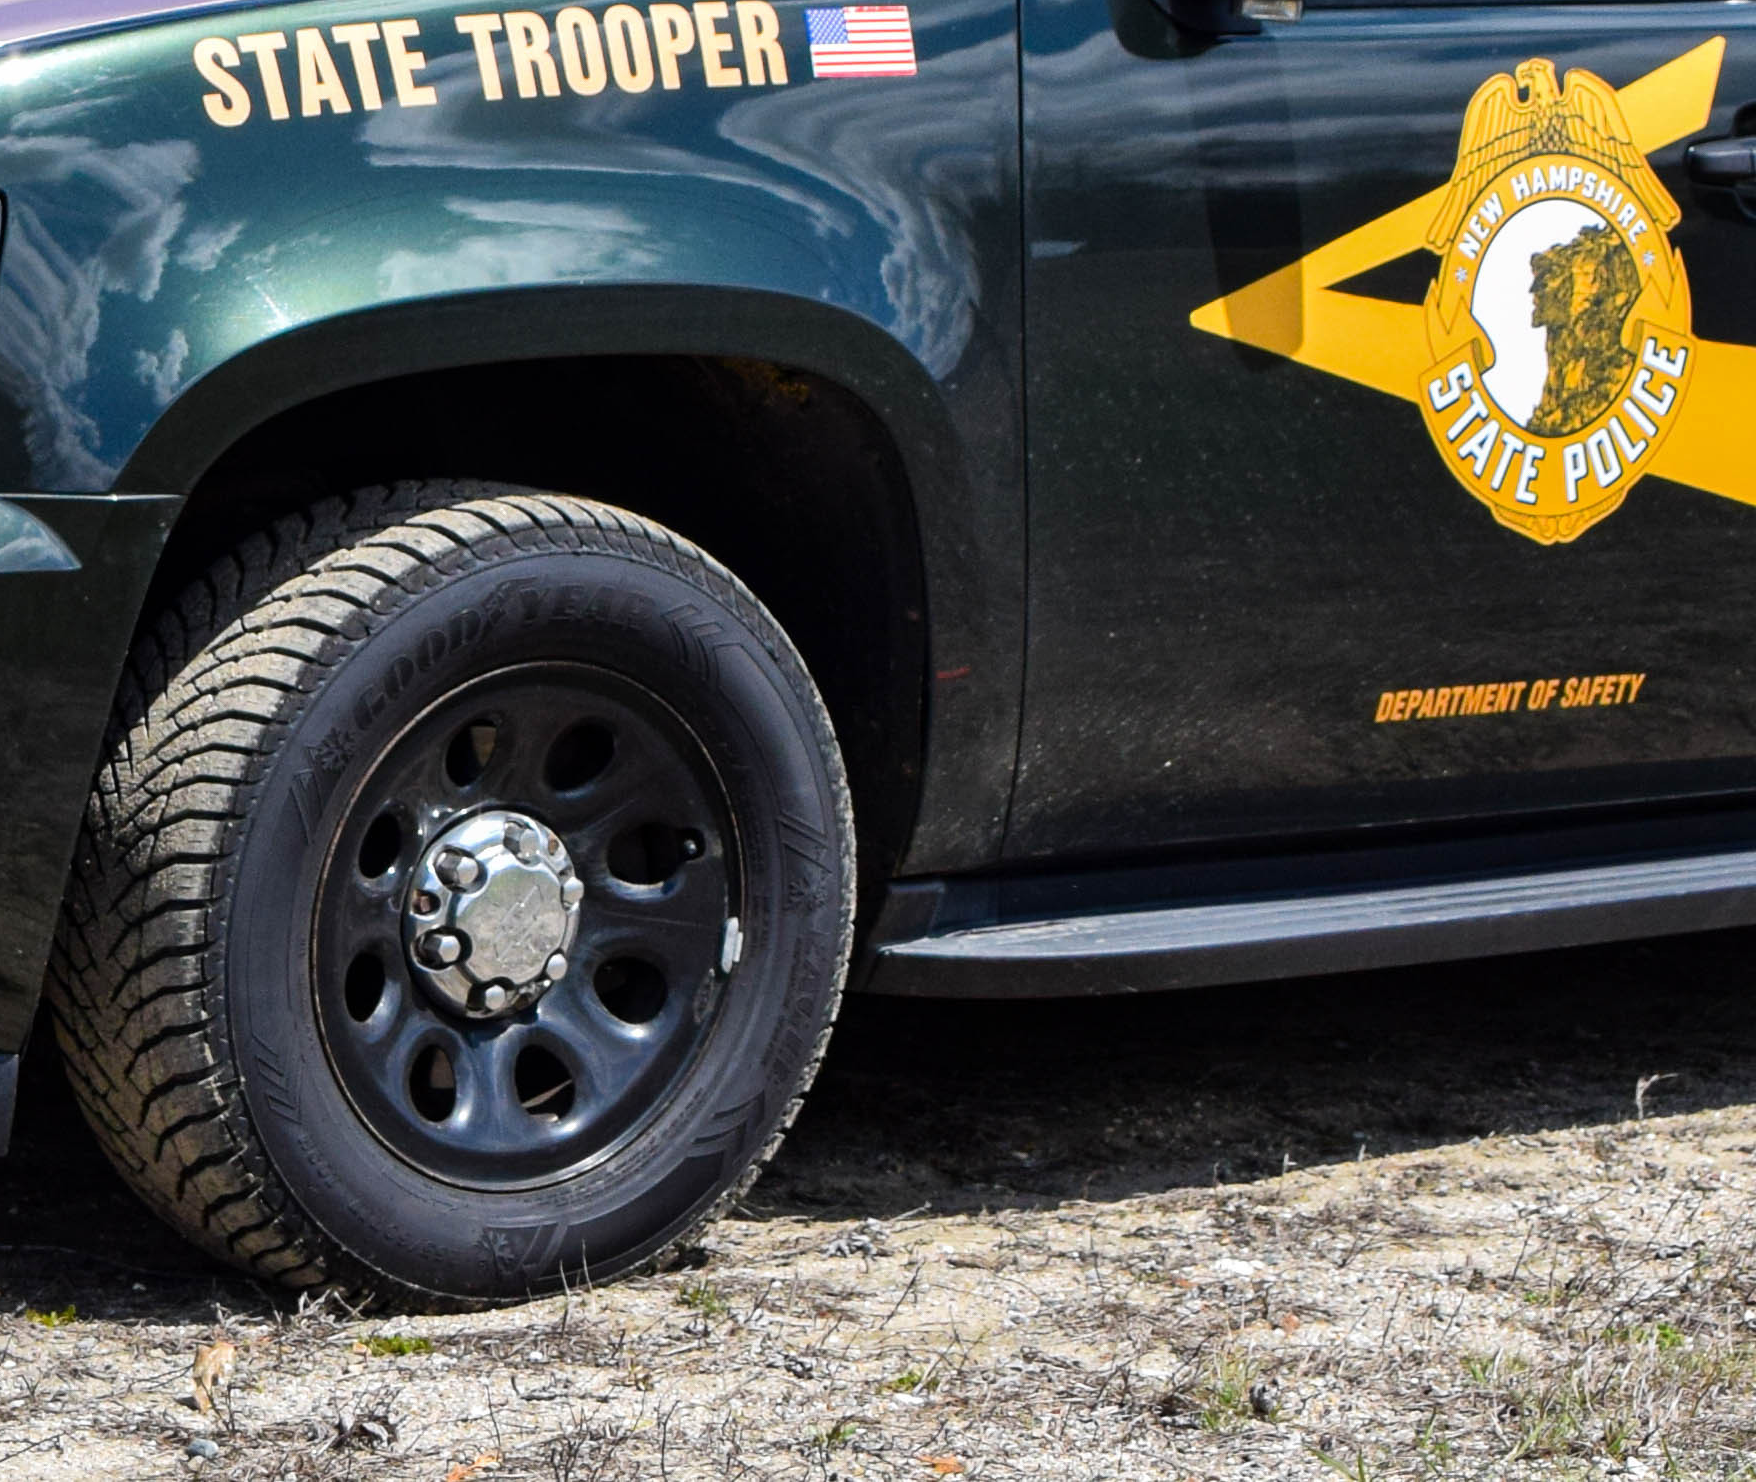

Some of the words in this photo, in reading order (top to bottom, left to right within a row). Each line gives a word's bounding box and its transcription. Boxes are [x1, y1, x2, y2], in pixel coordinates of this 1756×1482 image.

[192, 18, 437, 127] STATE
[455, 0, 789, 101] TROOPER
[1457, 192, 1504, 260] NEW
[1510, 165, 1648, 245] HAMPSHIRE
[1429, 361, 1545, 506] STATE
[1562, 336, 1690, 503] POLICE
[1374, 681, 1527, 723] DEPARTMENT
[1527, 678, 1560, 711] OF
[1559, 672, 1647, 709] SAFETY
